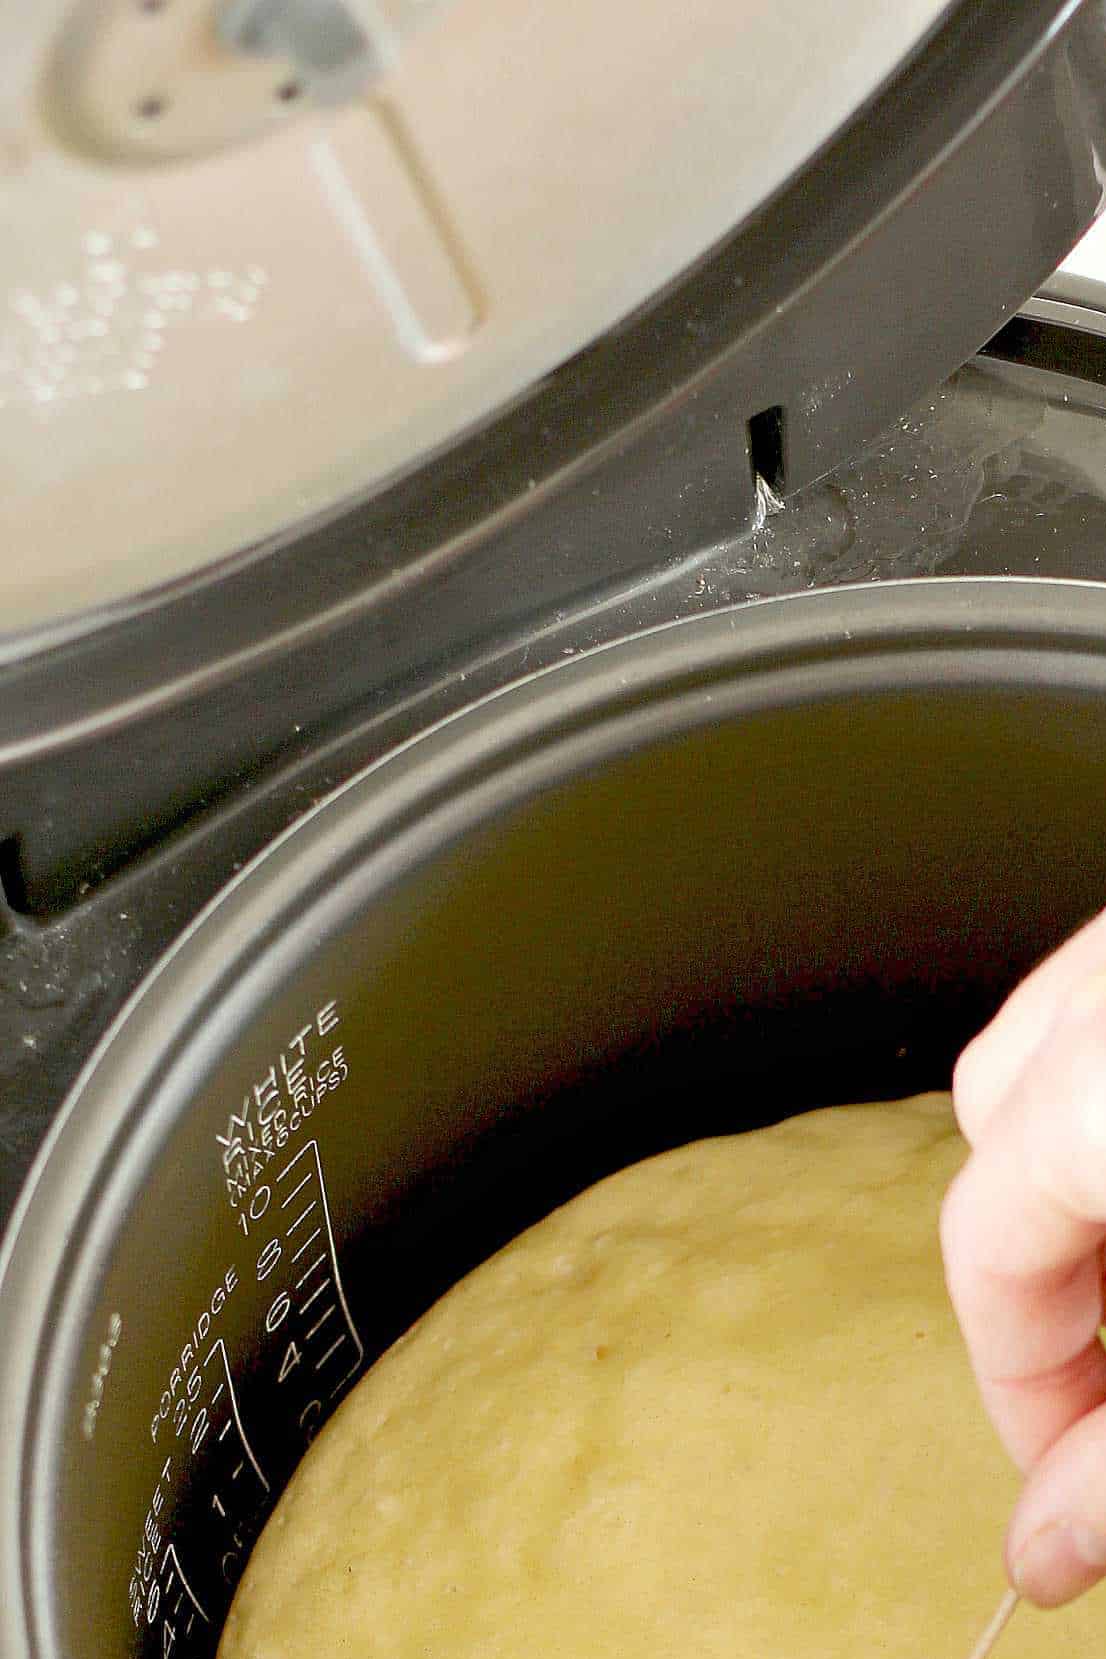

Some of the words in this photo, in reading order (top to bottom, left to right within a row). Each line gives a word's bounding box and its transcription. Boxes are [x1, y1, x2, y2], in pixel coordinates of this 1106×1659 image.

[216, 1000, 339, 1146] WHITE
[294, 1045, 344, 1108] RICE
[223, 1058, 304, 1175] RICE
[238, 1186, 271, 1235] 10
[257, 1239, 282, 1281] 8
[266, 1291, 290, 1332] 6
[152, 1264, 239, 1443] PORRIDGE
[277, 1341, 302, 1383] 4
[173, 1366, 202, 1437] 2.5
[190, 1408, 210, 1455] 2
[212, 1494, 225, 1517] 1
[129, 1456, 171, 1606] SWEET
[147, 1579, 160, 1624] 6
